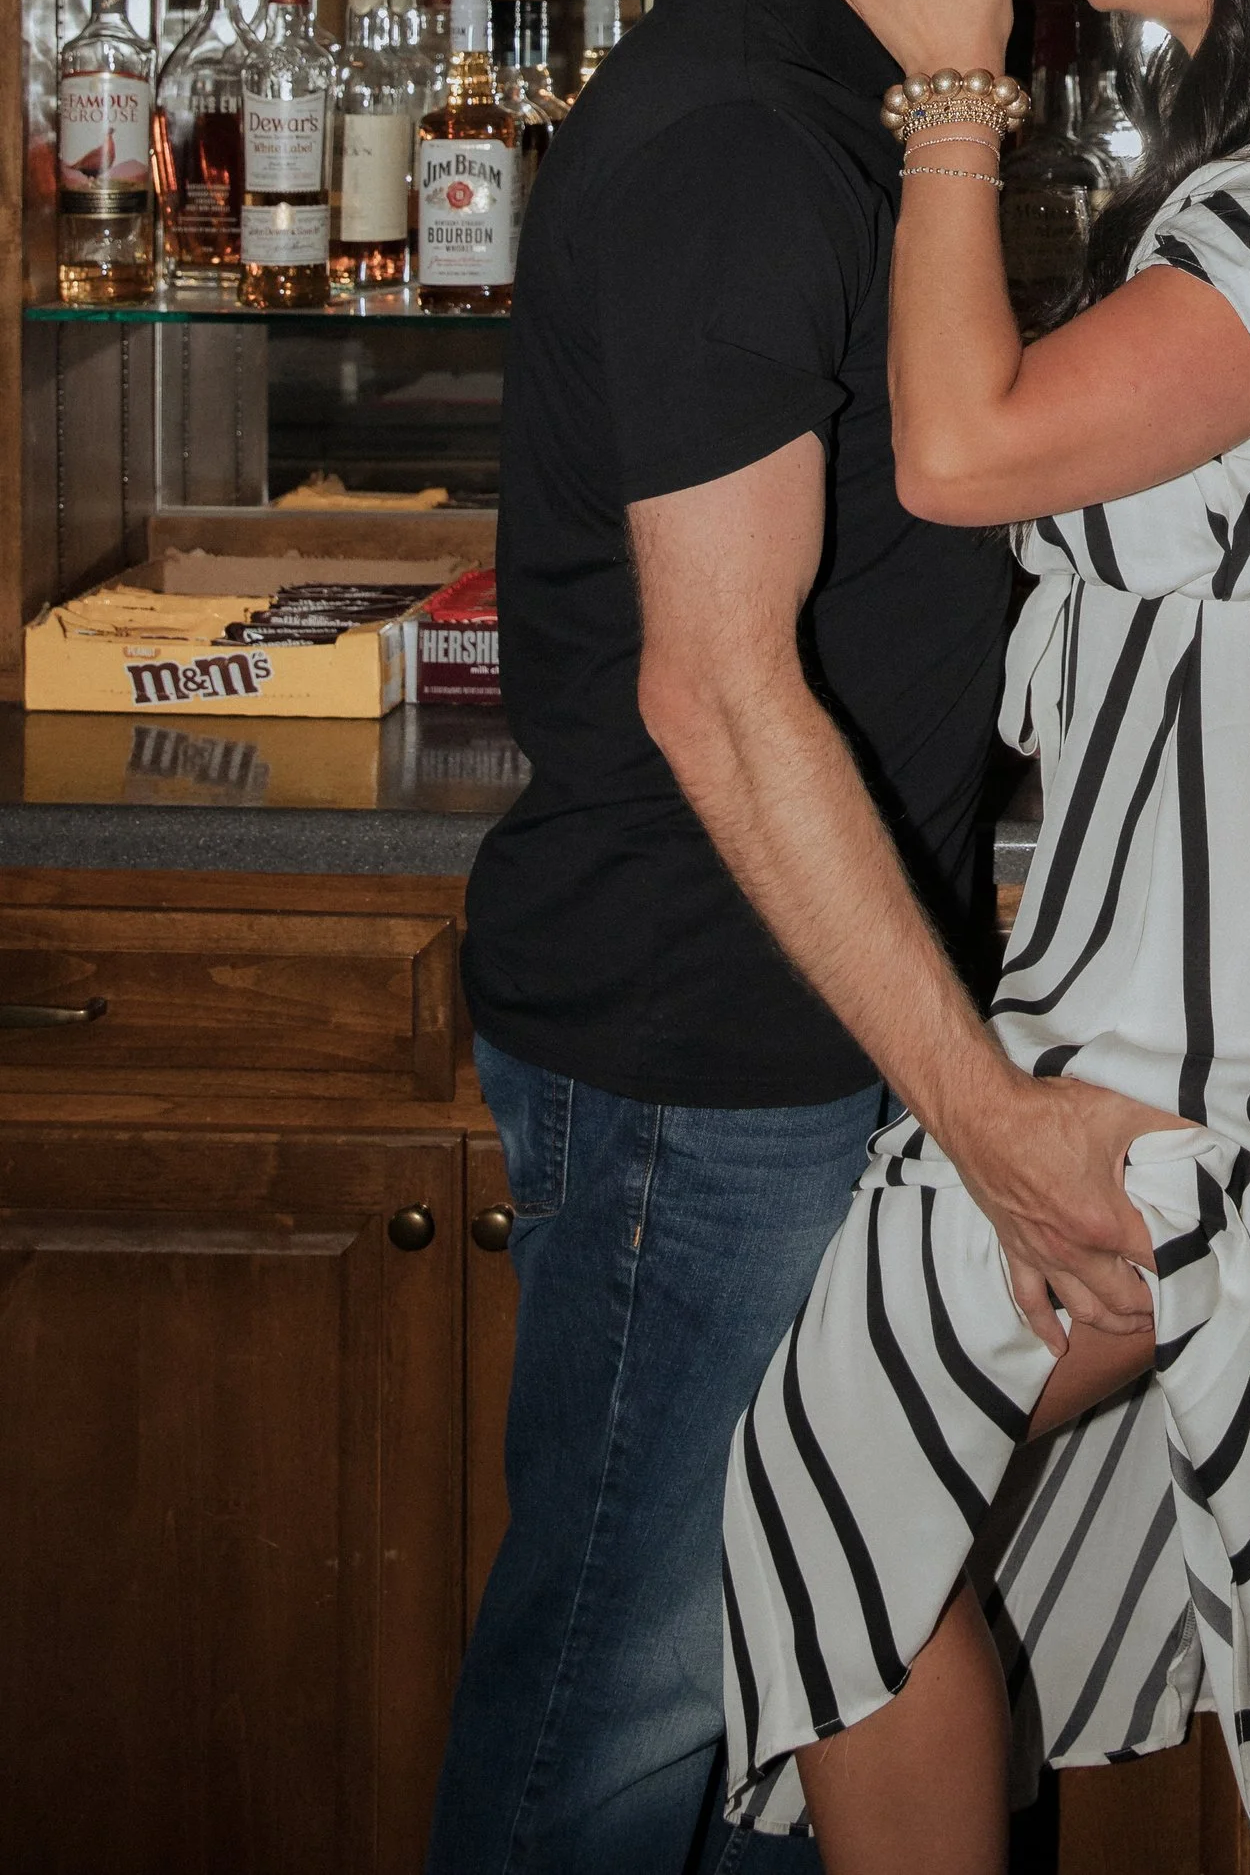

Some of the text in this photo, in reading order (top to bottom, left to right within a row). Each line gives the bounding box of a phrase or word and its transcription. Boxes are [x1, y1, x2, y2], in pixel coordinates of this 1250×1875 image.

[69, 93, 139, 109] FAMOUS
[69, 108, 139, 123] GROUSE
[249, 111, 319, 133] Dewar's
[423, 154, 503, 190] JIM BEAM
[427, 226, 494, 244] BOURBON
[127, 651, 272, 704] m&m's
[470, 666, 489, 675] milk
